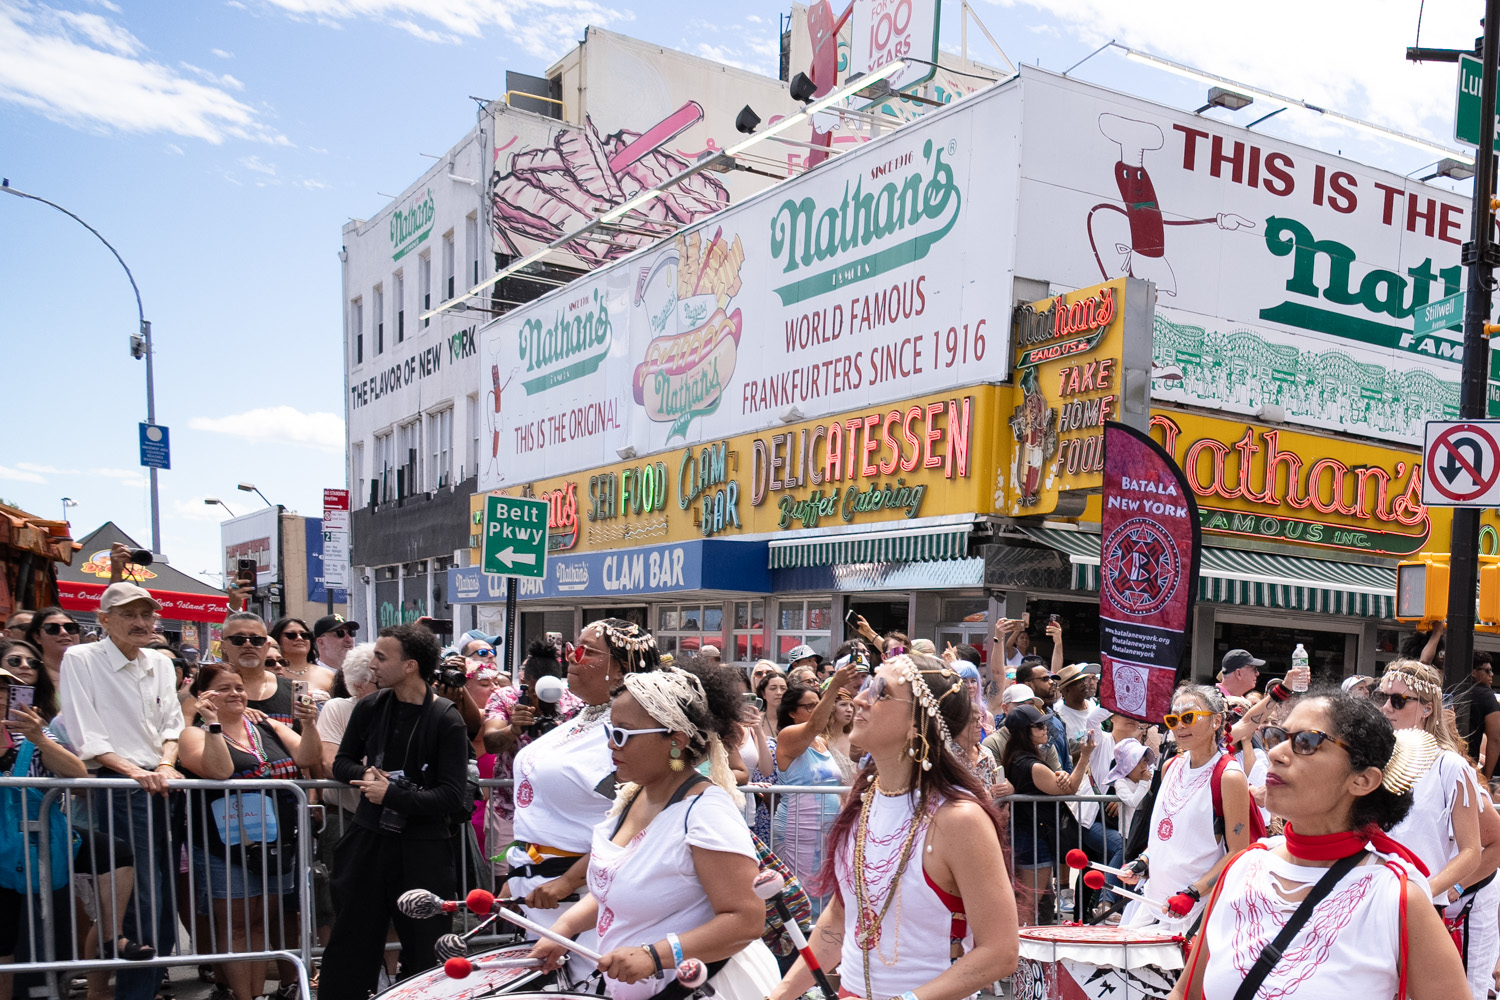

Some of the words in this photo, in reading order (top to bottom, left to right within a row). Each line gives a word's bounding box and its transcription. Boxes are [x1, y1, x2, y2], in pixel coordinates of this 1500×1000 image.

[869, 0, 912, 59] 100
[870, 158, 894, 181] SINCE
[894, 151, 914, 175] 1916
[1172, 123, 1295, 197] THIS
[1312, 164, 1358, 214] IS
[1374, 181, 1464, 246] THE
[390, 187, 436, 249] Nathan's
[770, 138, 956, 274] Nathan's
[518, 287, 611, 373] Nathan's
[785, 303, 844, 354] WORLD
[850, 275, 926, 335] FAMOUS
[1014, 286, 1118, 348] Nathan's
[1424, 298, 1455, 323] Stillwell
[351, 381, 368, 410] THE
[370, 363, 402, 401] FLAVOR
[403, 355, 416, 386] OF
[419, 343, 442, 380] NEW
[655, 356, 721, 416] Nathan's
[742, 351, 863, 415] FRANKFURTERS
[869, 335, 924, 386] SINCE
[933, 319, 987, 370] 1916
[1058, 357, 1119, 398] TAKE
[514, 423, 535, 454] THIS
[537, 420, 546, 449] IS
[547, 413, 567, 446] THE
[569, 397, 621, 441] ORIGINAL
[1057, 394, 1119, 433] HOME
[676, 440, 730, 511] CLAM
[750, 395, 976, 507] DELICATESSEN
[496, 503, 539, 523] Belt
[587, 471, 618, 523] SEA
[620, 460, 669, 517] FOOD
[701, 479, 743, 537] BAR
[777, 487, 841, 530] Buffet
[841, 478, 929, 523] Catering
[1107, 494, 1141, 513] NEW
[1143, 499, 1188, 519] YORK
[1121, 475, 1178, 497] BATALÁ
[489, 521, 544, 546] Pkwy
[487, 575, 507, 598] CLA
[602, 553, 645, 591] CLAM
[649, 547, 685, 589] BAR
[176, 600, 205, 611] Island
